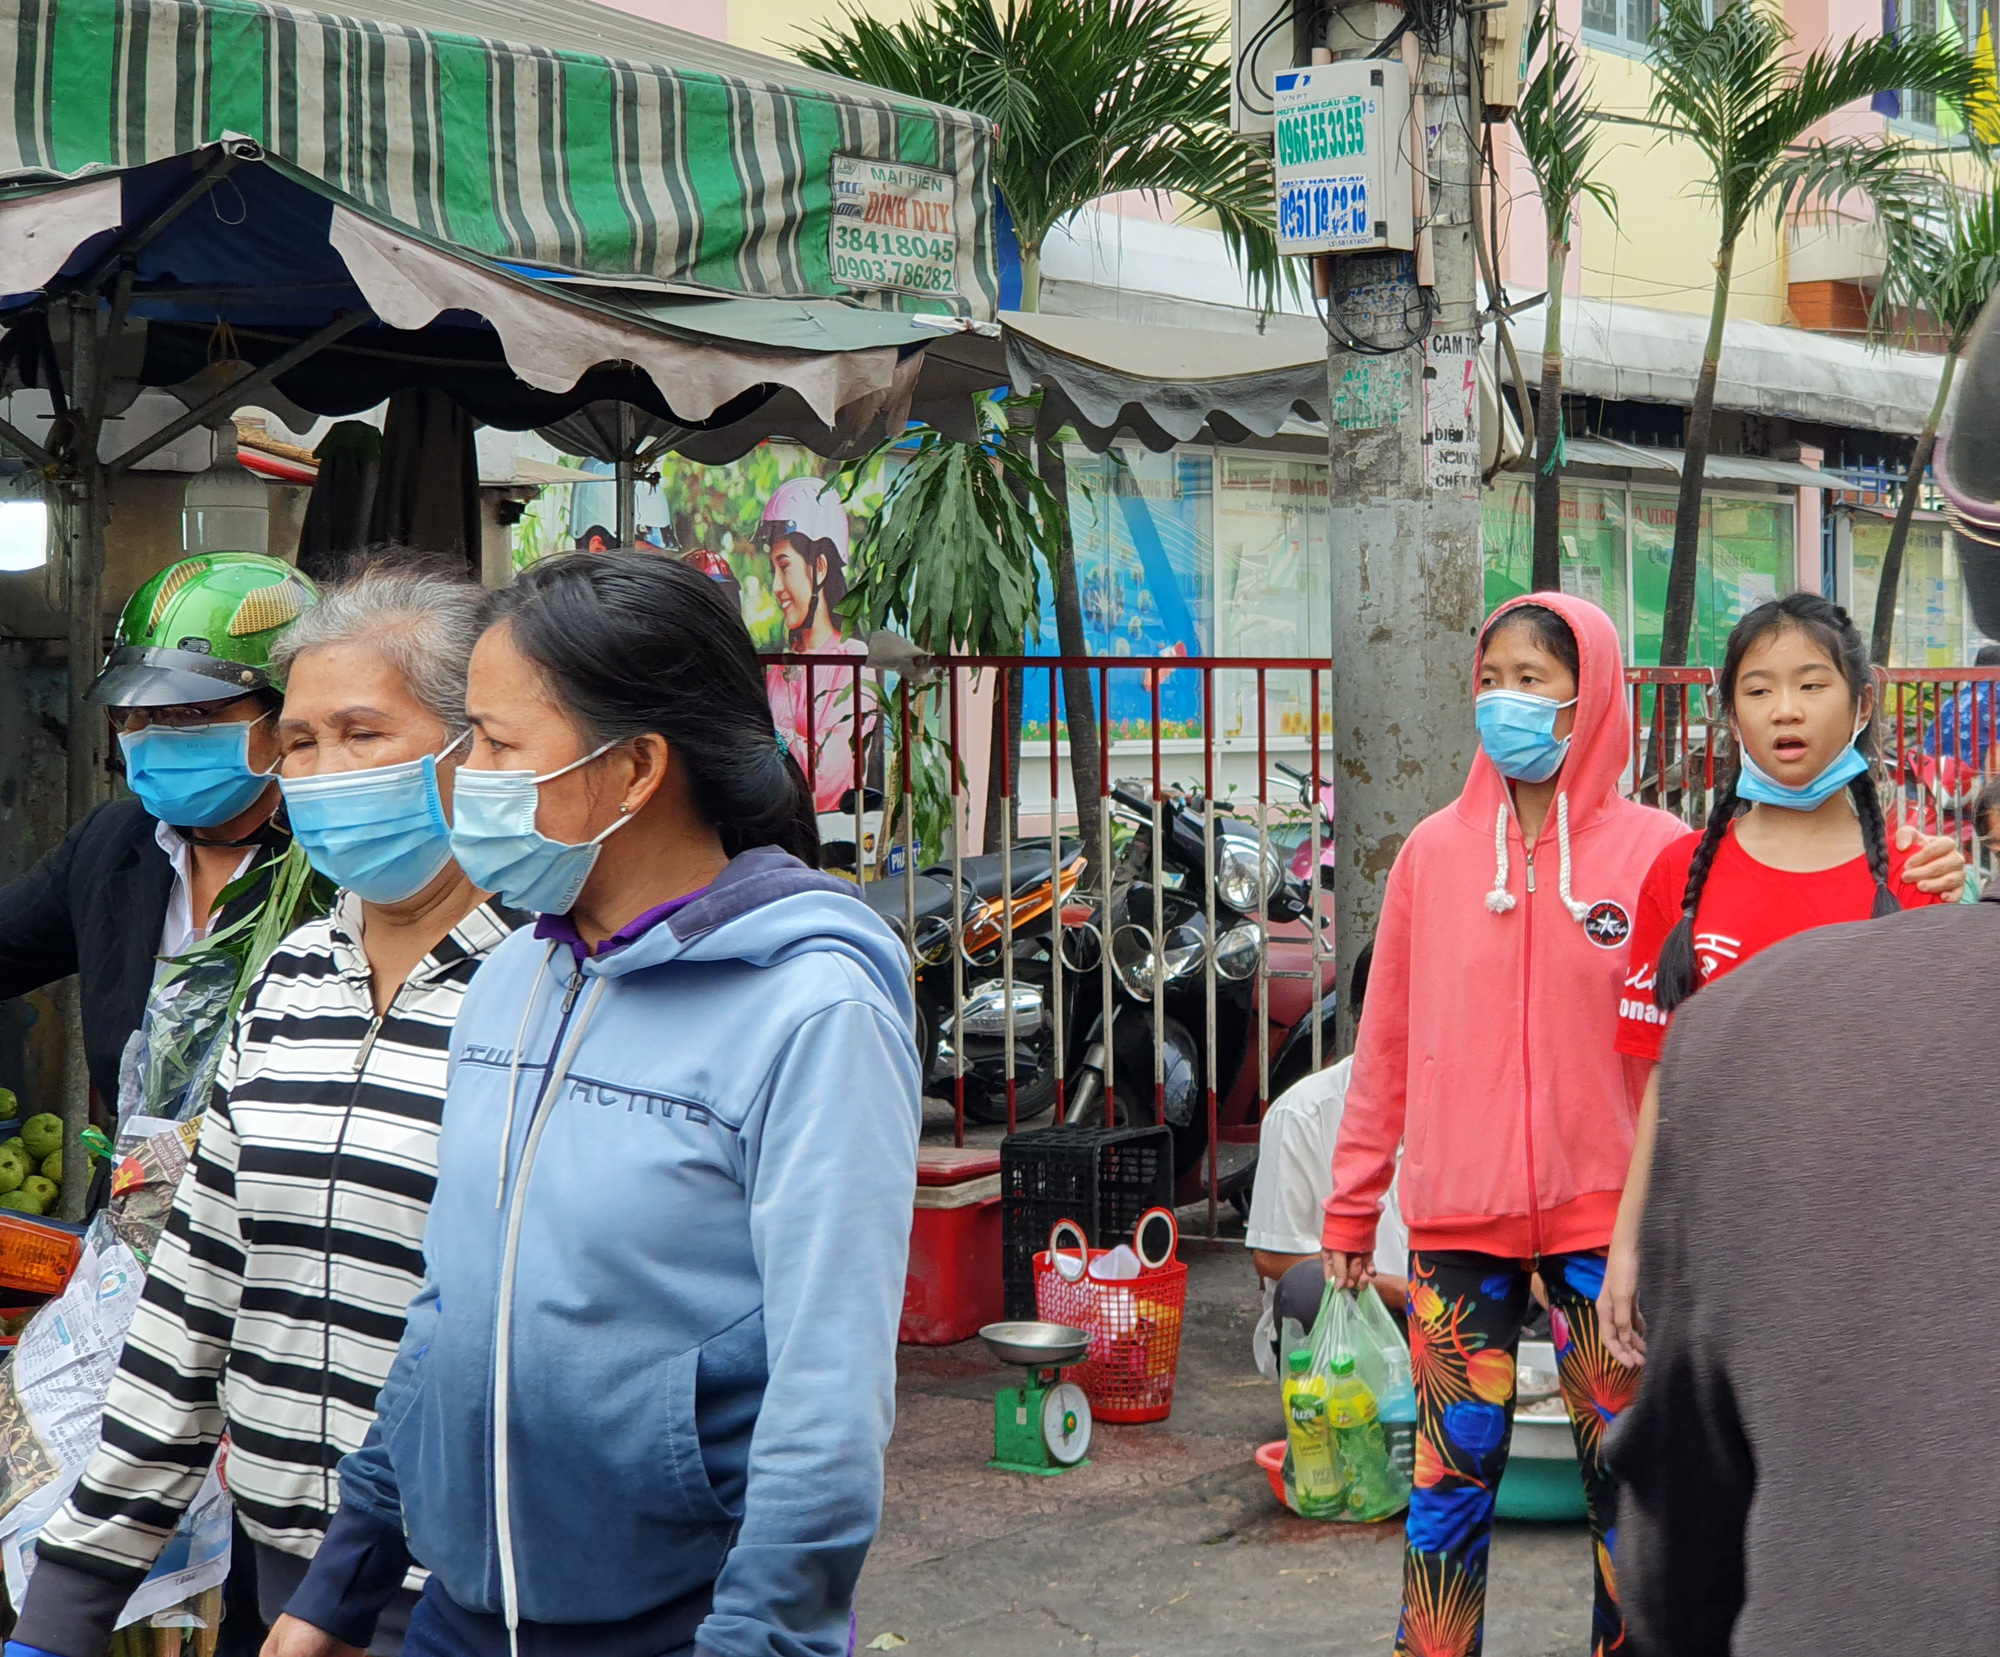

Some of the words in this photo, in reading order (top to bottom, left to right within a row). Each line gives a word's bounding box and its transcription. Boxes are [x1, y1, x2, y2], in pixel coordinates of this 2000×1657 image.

[1282, 93, 1308, 102] VNPT
[912, 198, 950, 234] DUY
[835, 225, 954, 264] 38418045
[837, 254, 954, 292] 0903.786282
[1291, 1407, 1317, 1421] fuze
